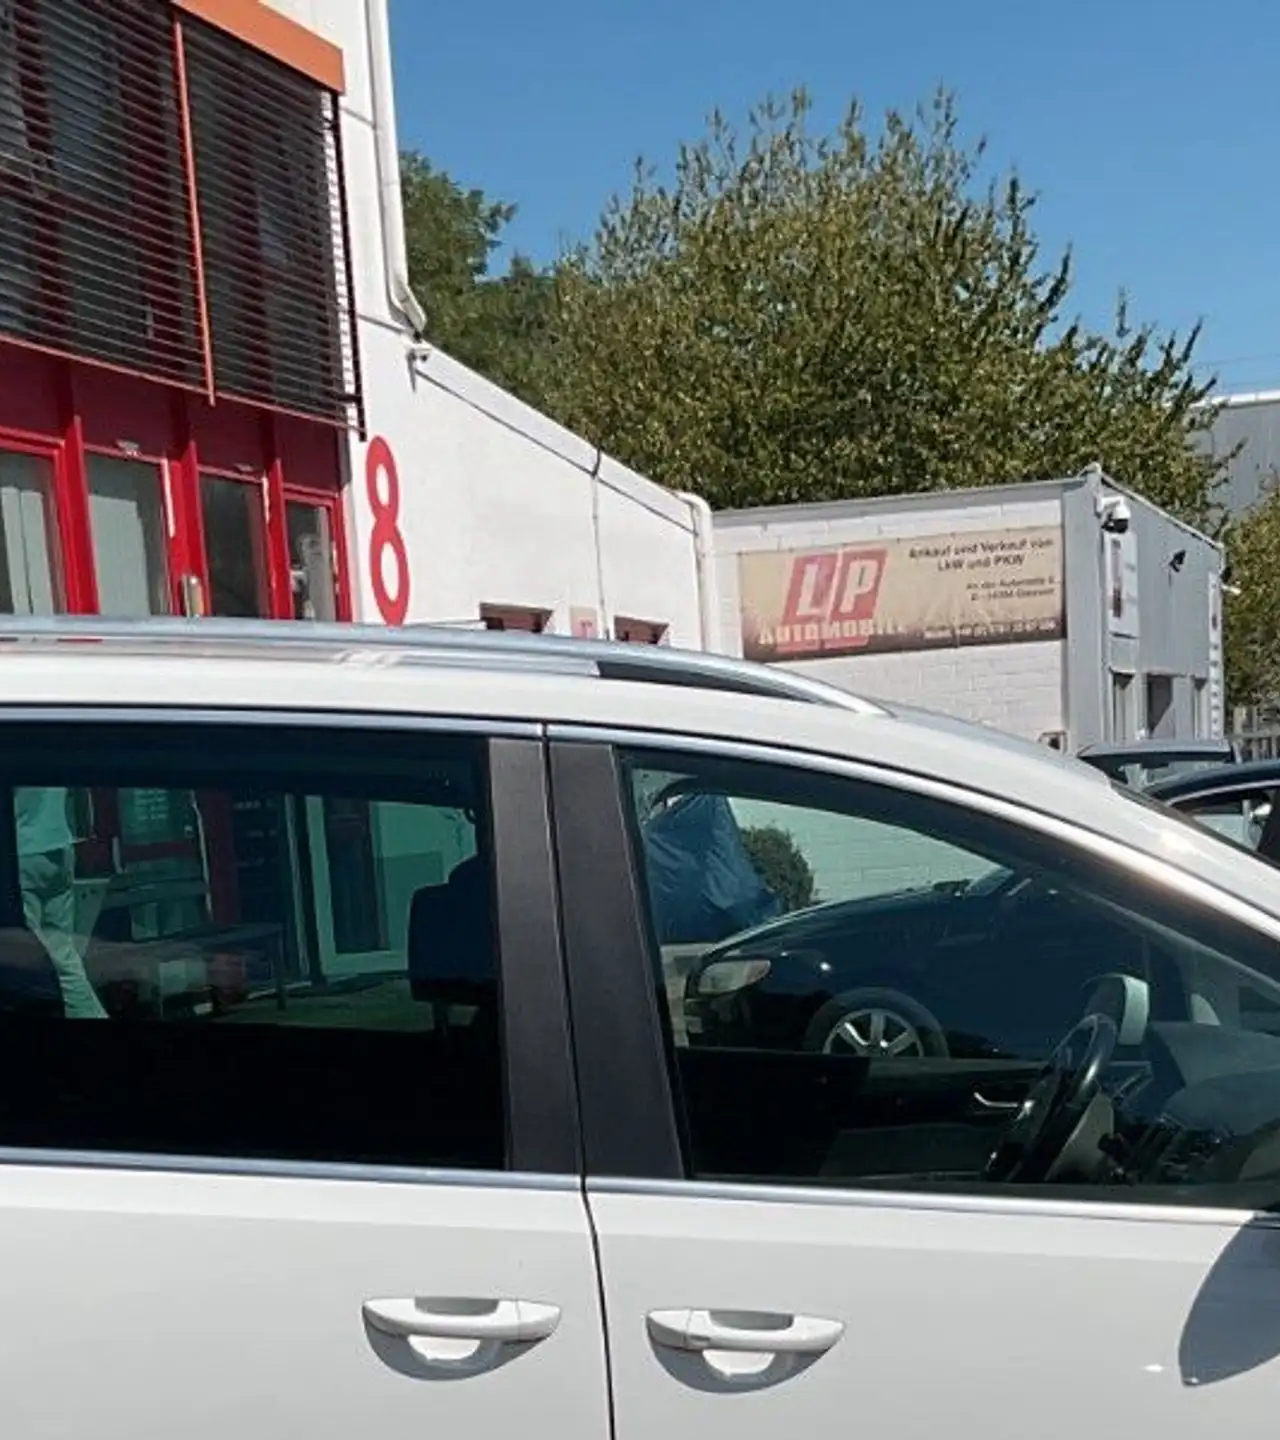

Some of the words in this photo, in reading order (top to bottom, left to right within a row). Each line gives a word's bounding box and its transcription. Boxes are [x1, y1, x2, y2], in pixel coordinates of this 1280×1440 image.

[366, 436, 410, 628] 8
[954, 543, 978, 555] und
[980, 538, 1027, 551] Verkauf
[967, 556, 991, 570] und
[993, 553, 1026, 566] PKW
[795, 558, 880, 616] LP
